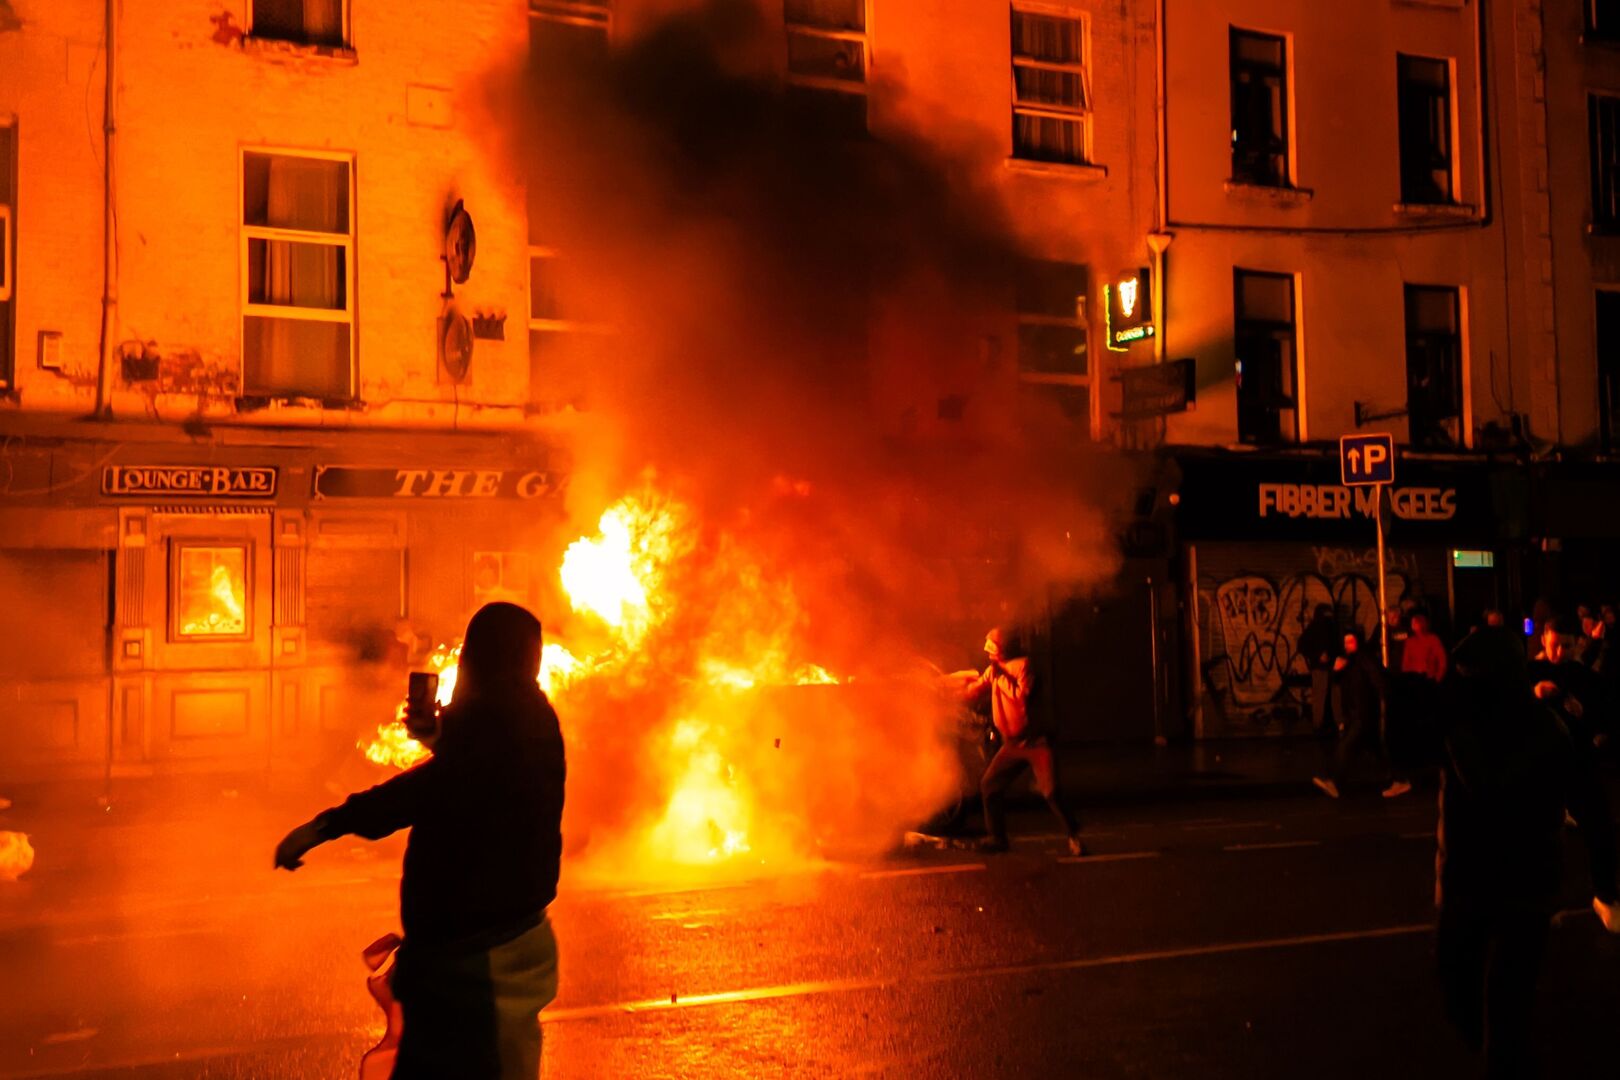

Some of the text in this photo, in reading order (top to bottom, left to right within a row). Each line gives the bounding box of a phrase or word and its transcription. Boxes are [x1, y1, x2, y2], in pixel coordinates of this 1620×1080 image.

[1363, 444, 1387, 475] P
[112, 466, 269, 494] LOUNGE BAR
[394, 469, 503, 498] THE
[1259, 483, 1351, 519] FIBBER
